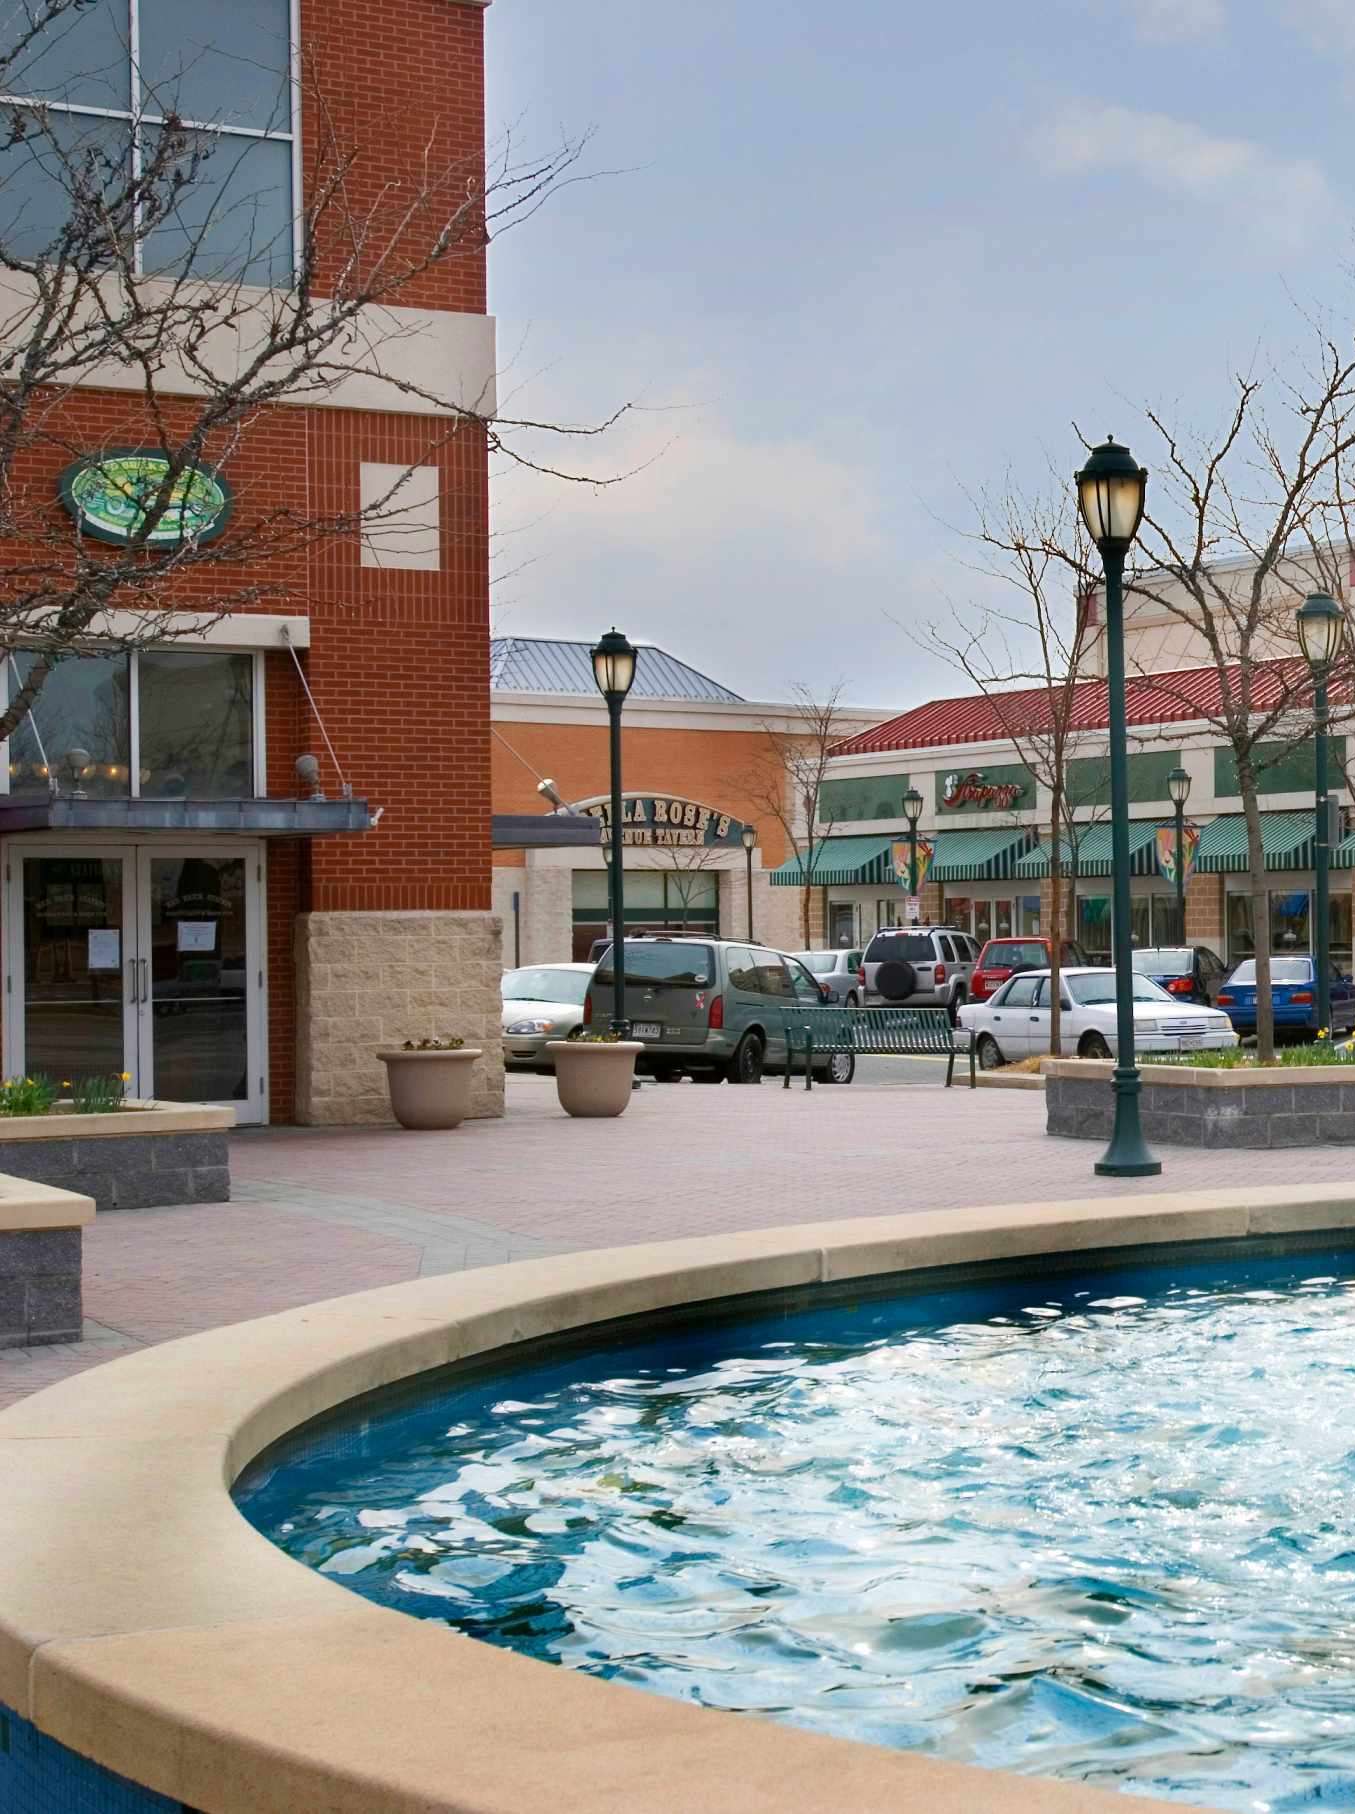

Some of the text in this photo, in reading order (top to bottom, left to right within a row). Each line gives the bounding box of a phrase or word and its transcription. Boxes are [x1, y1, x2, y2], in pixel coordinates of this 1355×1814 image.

[582, 799, 732, 838] ELA ROSE'S
[600, 827, 706, 845] AVNUE TAVERN
